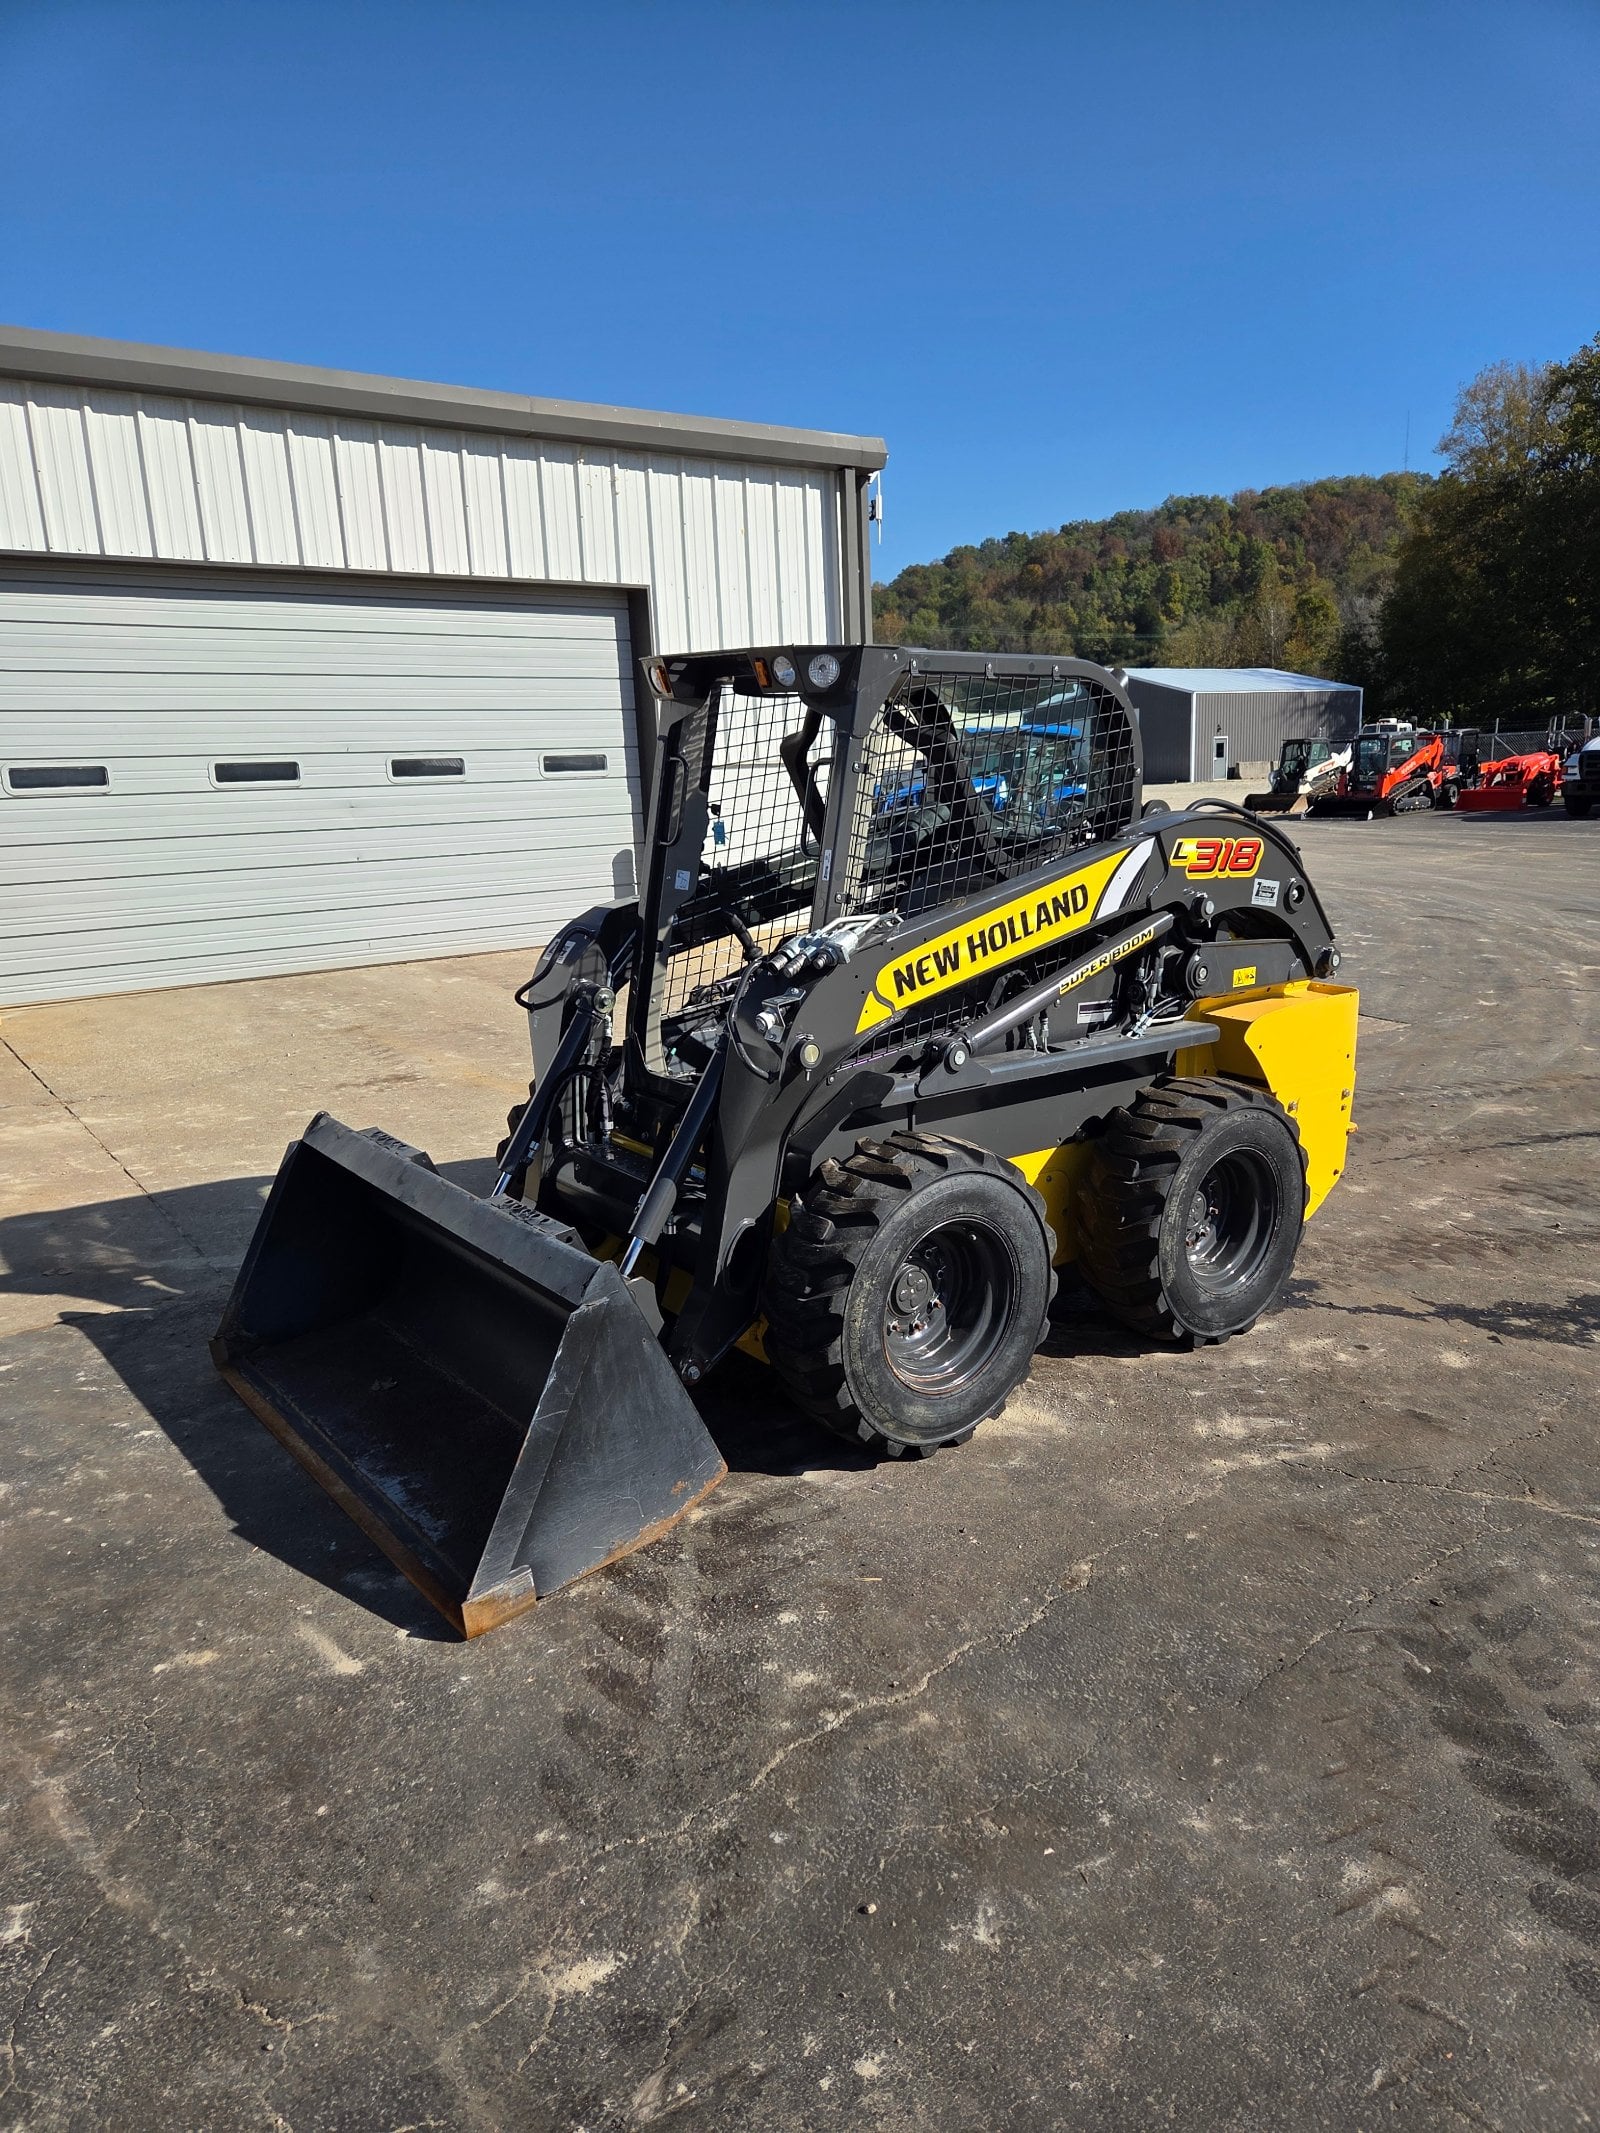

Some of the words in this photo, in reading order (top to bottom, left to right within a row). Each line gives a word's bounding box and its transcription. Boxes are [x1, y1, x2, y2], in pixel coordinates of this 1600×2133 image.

[893, 941, 960, 998] NEW
[966, 883, 1089, 963] HOLLAND
[1060, 954, 1109, 993] SUPER
[1111, 928, 1154, 960] BOOM
